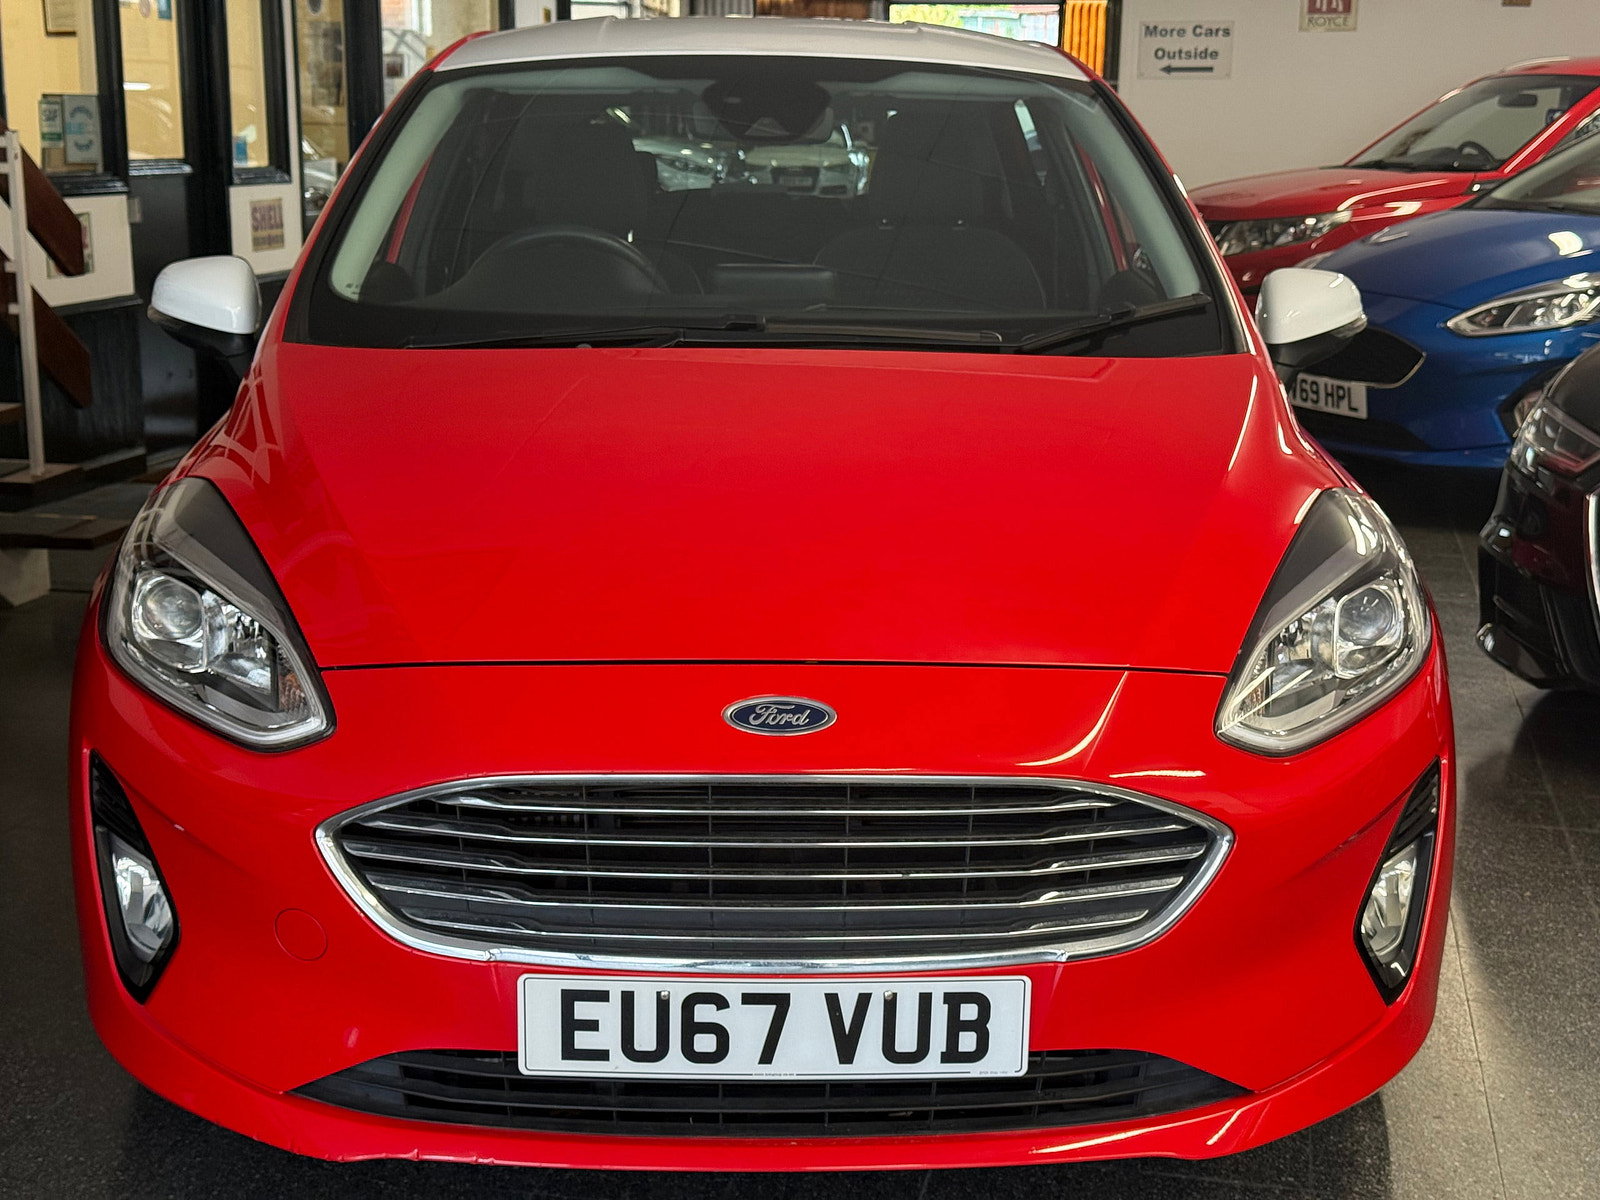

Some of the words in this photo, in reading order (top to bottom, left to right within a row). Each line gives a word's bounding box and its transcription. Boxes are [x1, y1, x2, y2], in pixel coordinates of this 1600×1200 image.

[1308, 16, 1350, 28] ROYCE
[1144, 25, 1187, 38] More
[1192, 25, 1231, 38] Cars
[1154, 47, 1219, 60] Outside
[1324, 384, 1359, 412] HPL
[748, 703, 811, 725] Ford
[560, 988, 791, 1065] EU67
[824, 991, 992, 1065] VUB
